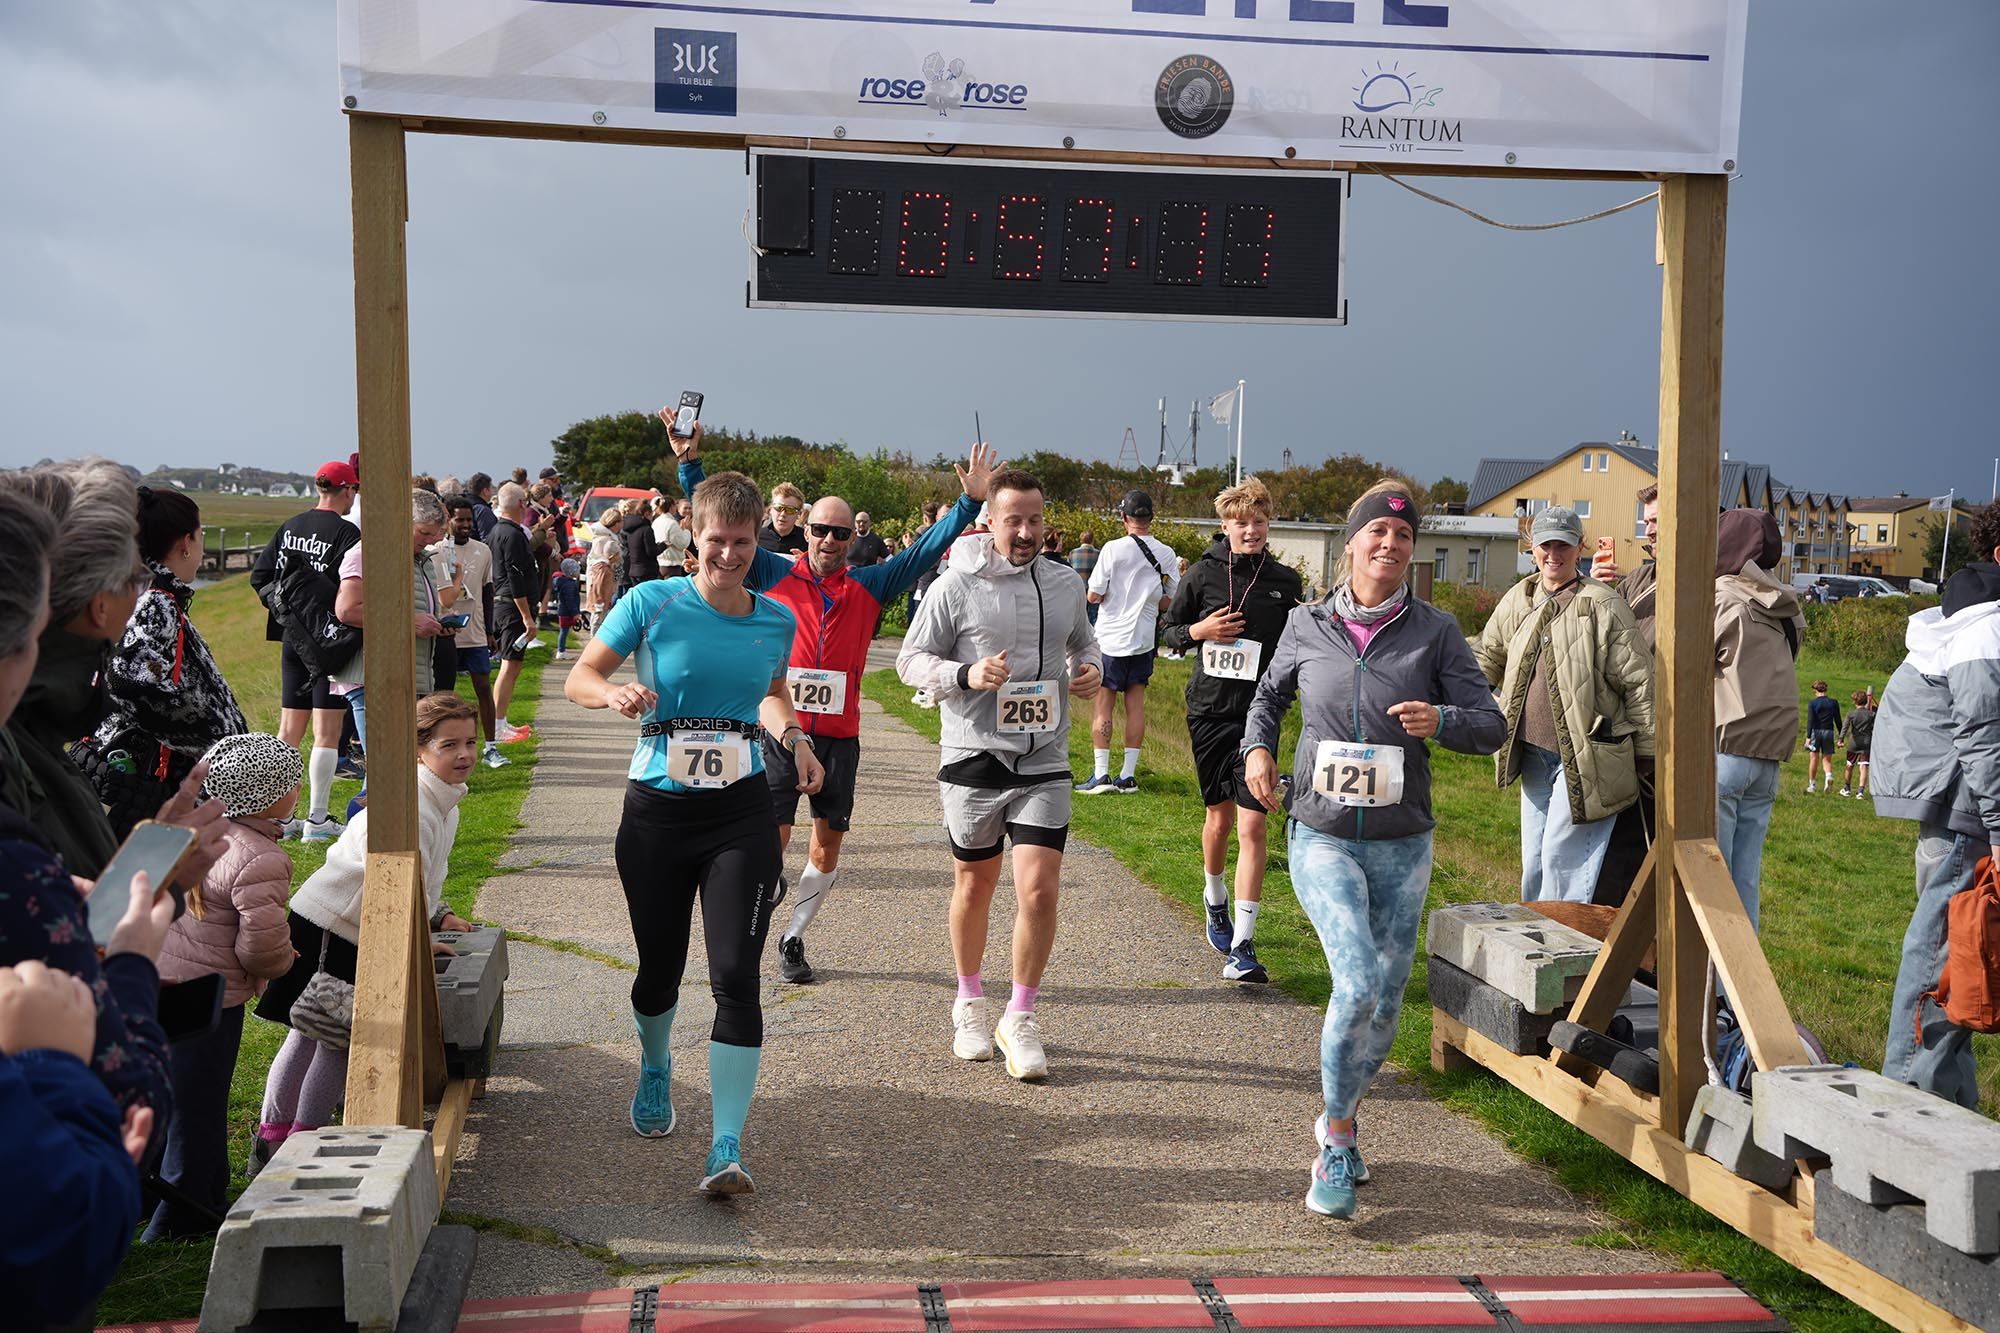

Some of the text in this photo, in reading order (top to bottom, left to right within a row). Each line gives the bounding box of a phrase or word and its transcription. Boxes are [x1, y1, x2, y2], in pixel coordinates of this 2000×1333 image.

[679, 77, 713, 86] TUI BLUE
[1160, 57, 1198, 90] FRIESEN
[688, 92, 703, 102] Sylt
[859, 77, 1028, 105] rose rose
[1340, 116, 1463, 142] RANTUM
[1389, 143, 1414, 153] SYLT
[281, 529, 332, 561] Sunday
[1208, 650, 1245, 671] 180
[792, 683, 832, 706] 120
[671, 718, 732, 730] SUNDRIED
[1003, 699, 1048, 724] 263
[684, 748, 723, 777] 76
[1322, 763, 1377, 796] 121
[750, 882, 765, 936] ENDURANCE
